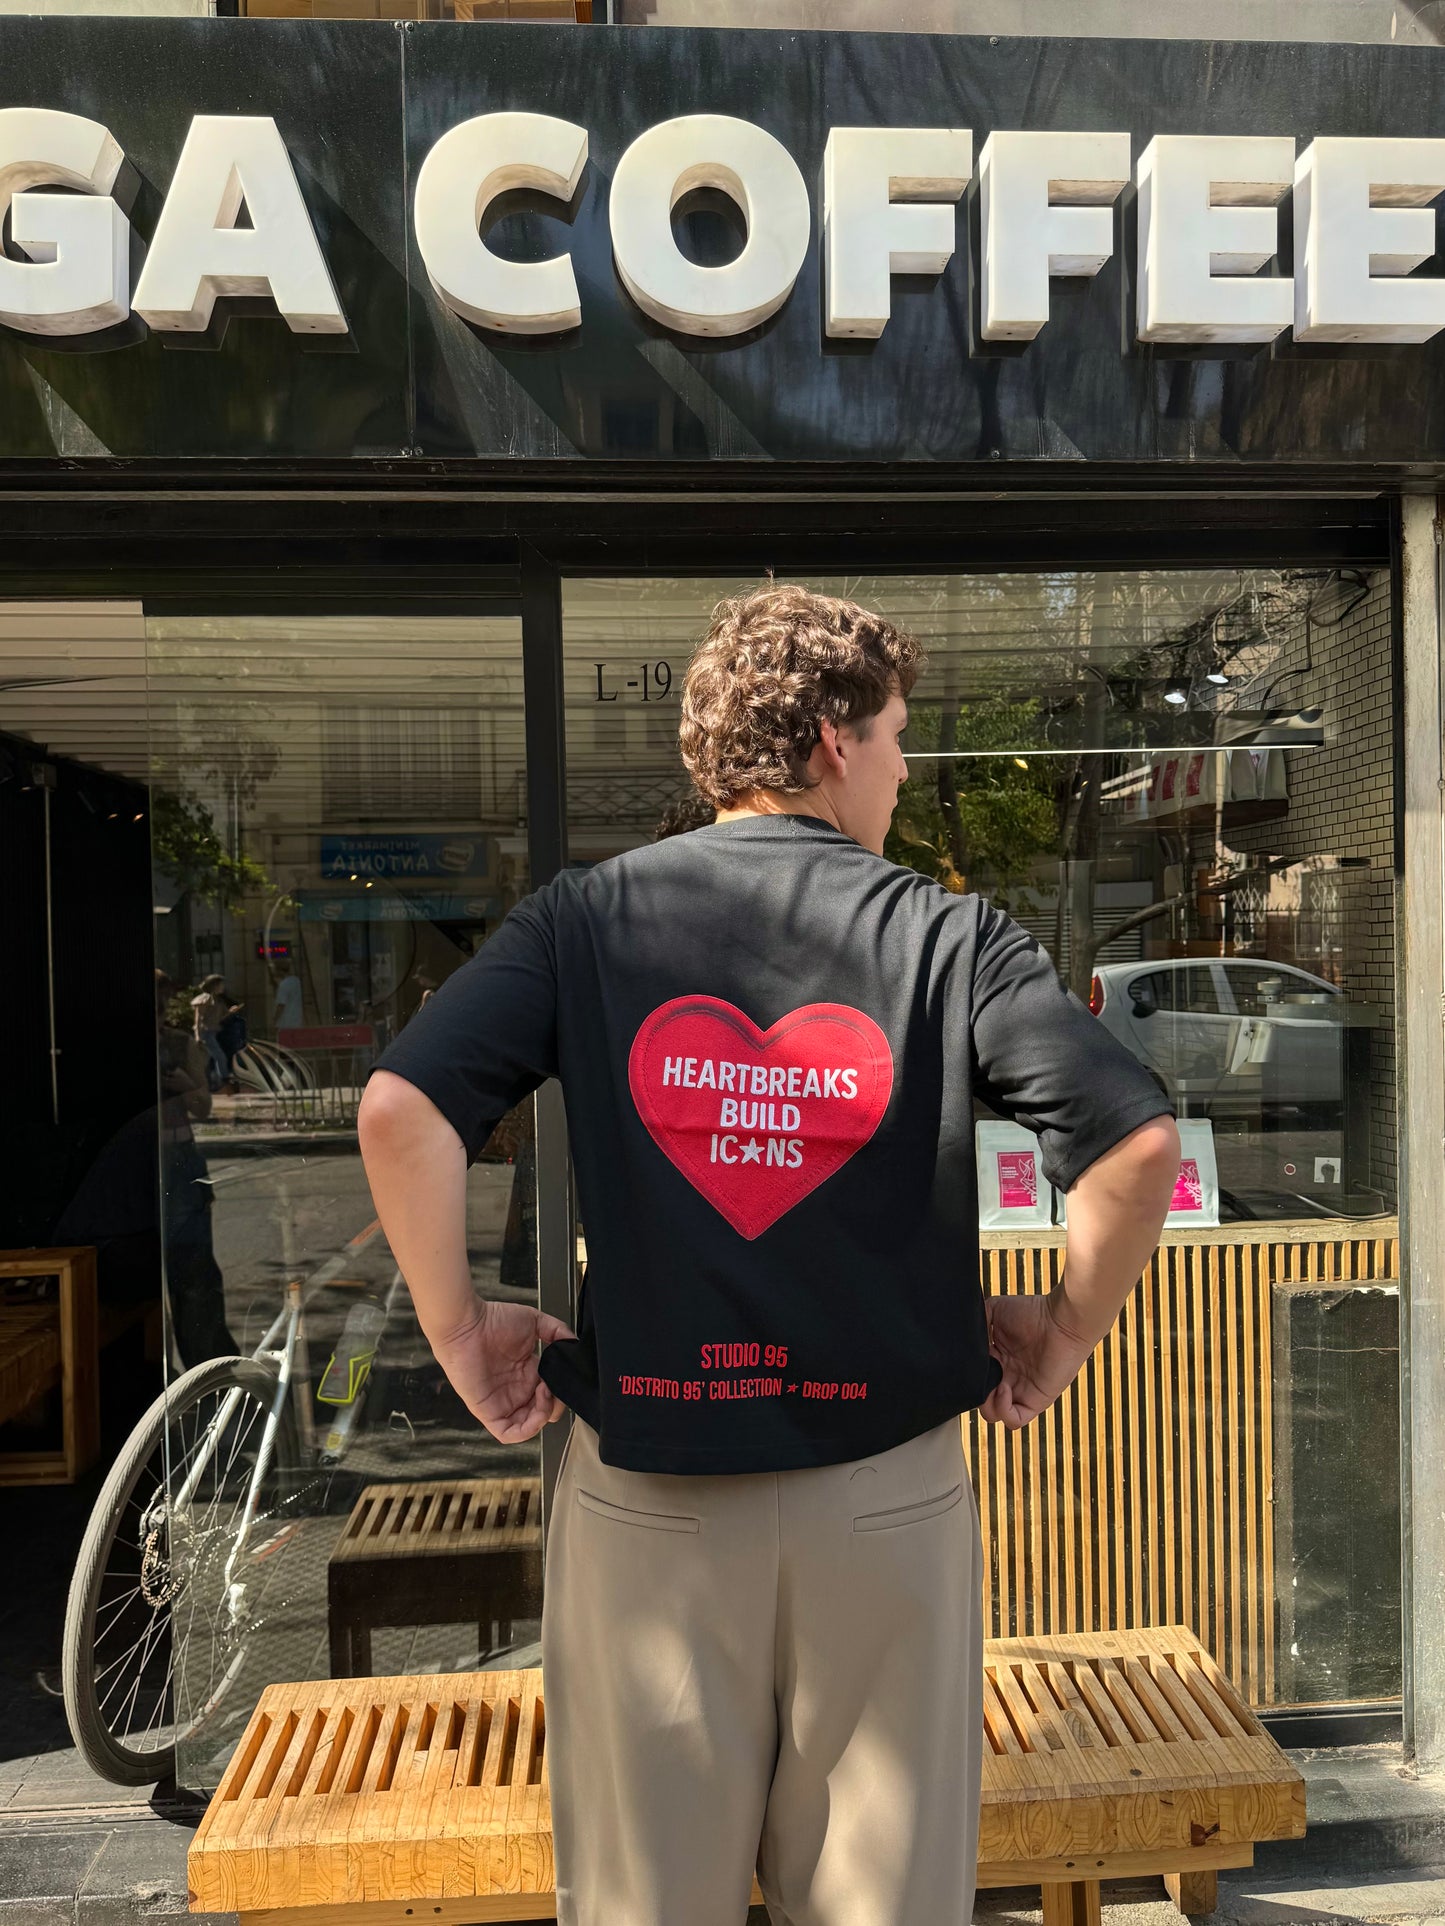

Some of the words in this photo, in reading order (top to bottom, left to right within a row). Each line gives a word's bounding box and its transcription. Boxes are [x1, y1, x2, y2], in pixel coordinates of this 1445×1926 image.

[0, 107, 348, 336] GA
[414, 111, 1445, 344] COFFEE
[663, 1056, 858, 1100] HEARTBREAKS
[720, 1098, 801, 1131] BUILD
[701, 1343, 760, 1369] STUDIO
[764, 1344, 788, 1368] 95
[709, 1378, 783, 1400] COLLECTION
[802, 1381, 839, 1400] DROP
[841, 1382, 868, 1400] 004
